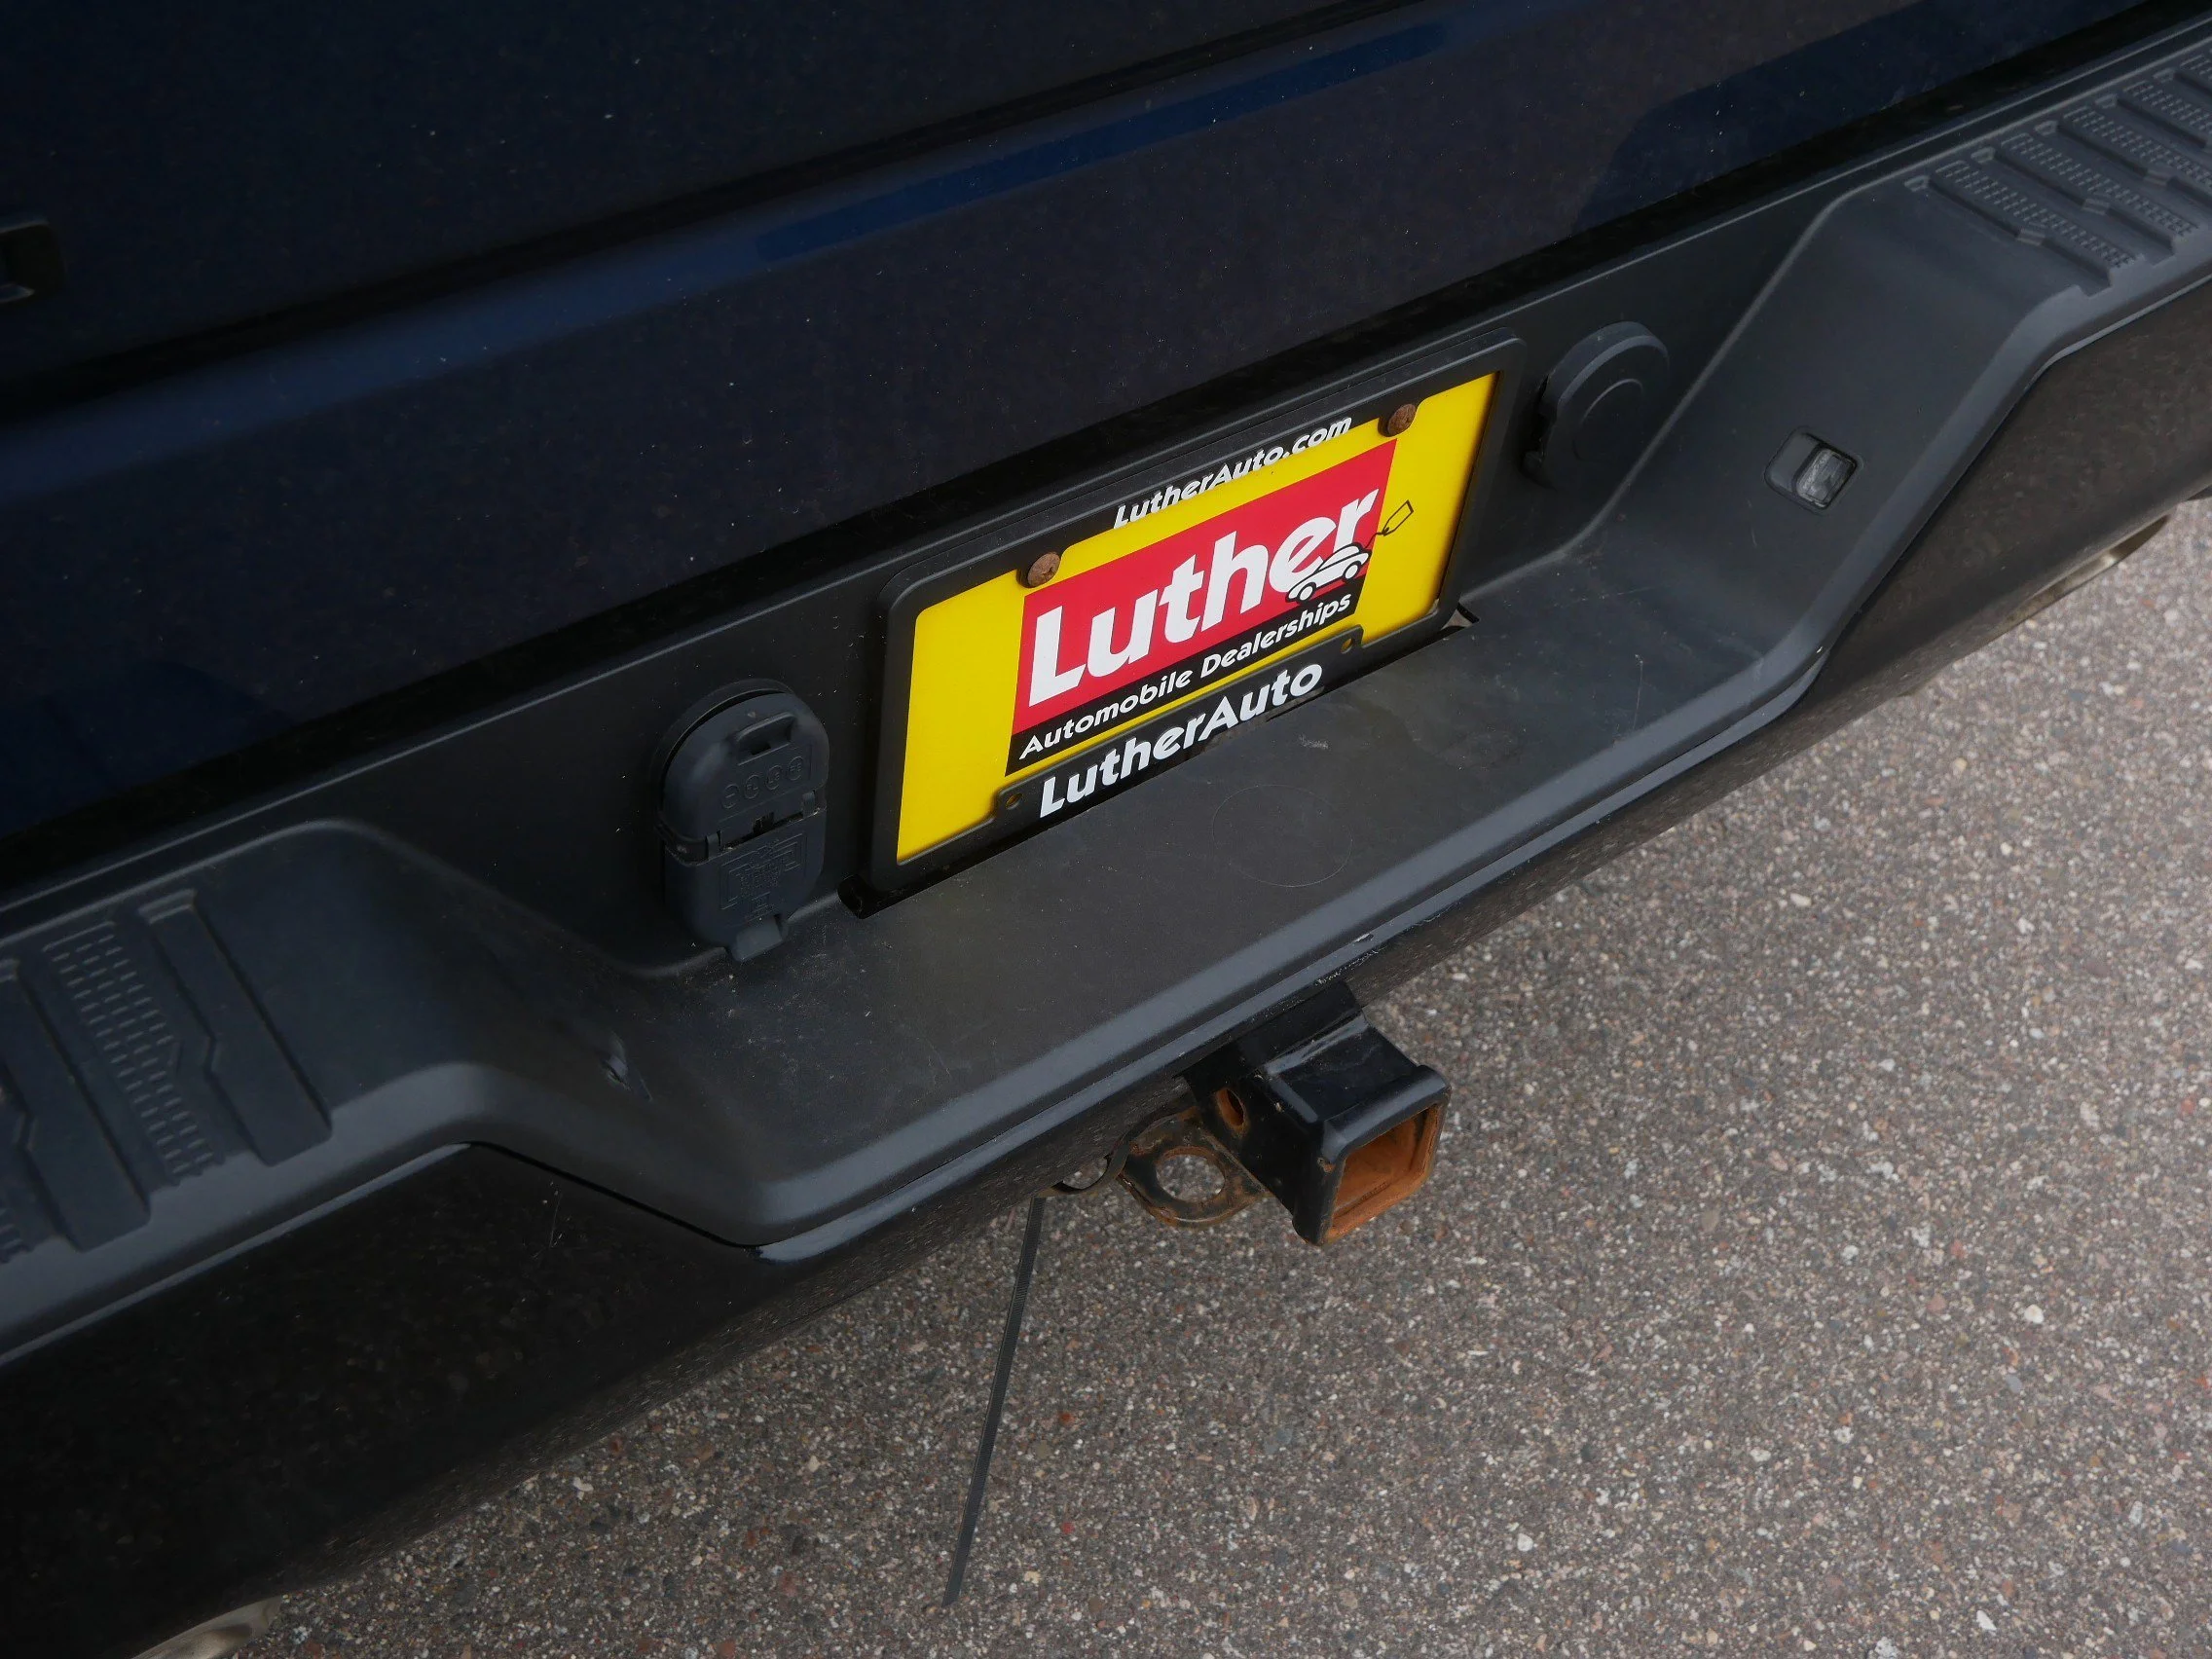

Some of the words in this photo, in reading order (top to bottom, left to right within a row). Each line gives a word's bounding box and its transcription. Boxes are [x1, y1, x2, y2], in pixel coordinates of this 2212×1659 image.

[1113, 416, 1353, 529] LutherAuto.com
[1018, 668, 1191, 759] Automobile
[1200, 592, 1351, 679] Dealerships
[1029, 489, 1380, 707] Luther
[1040, 662, 1322, 817] LutherAuto
